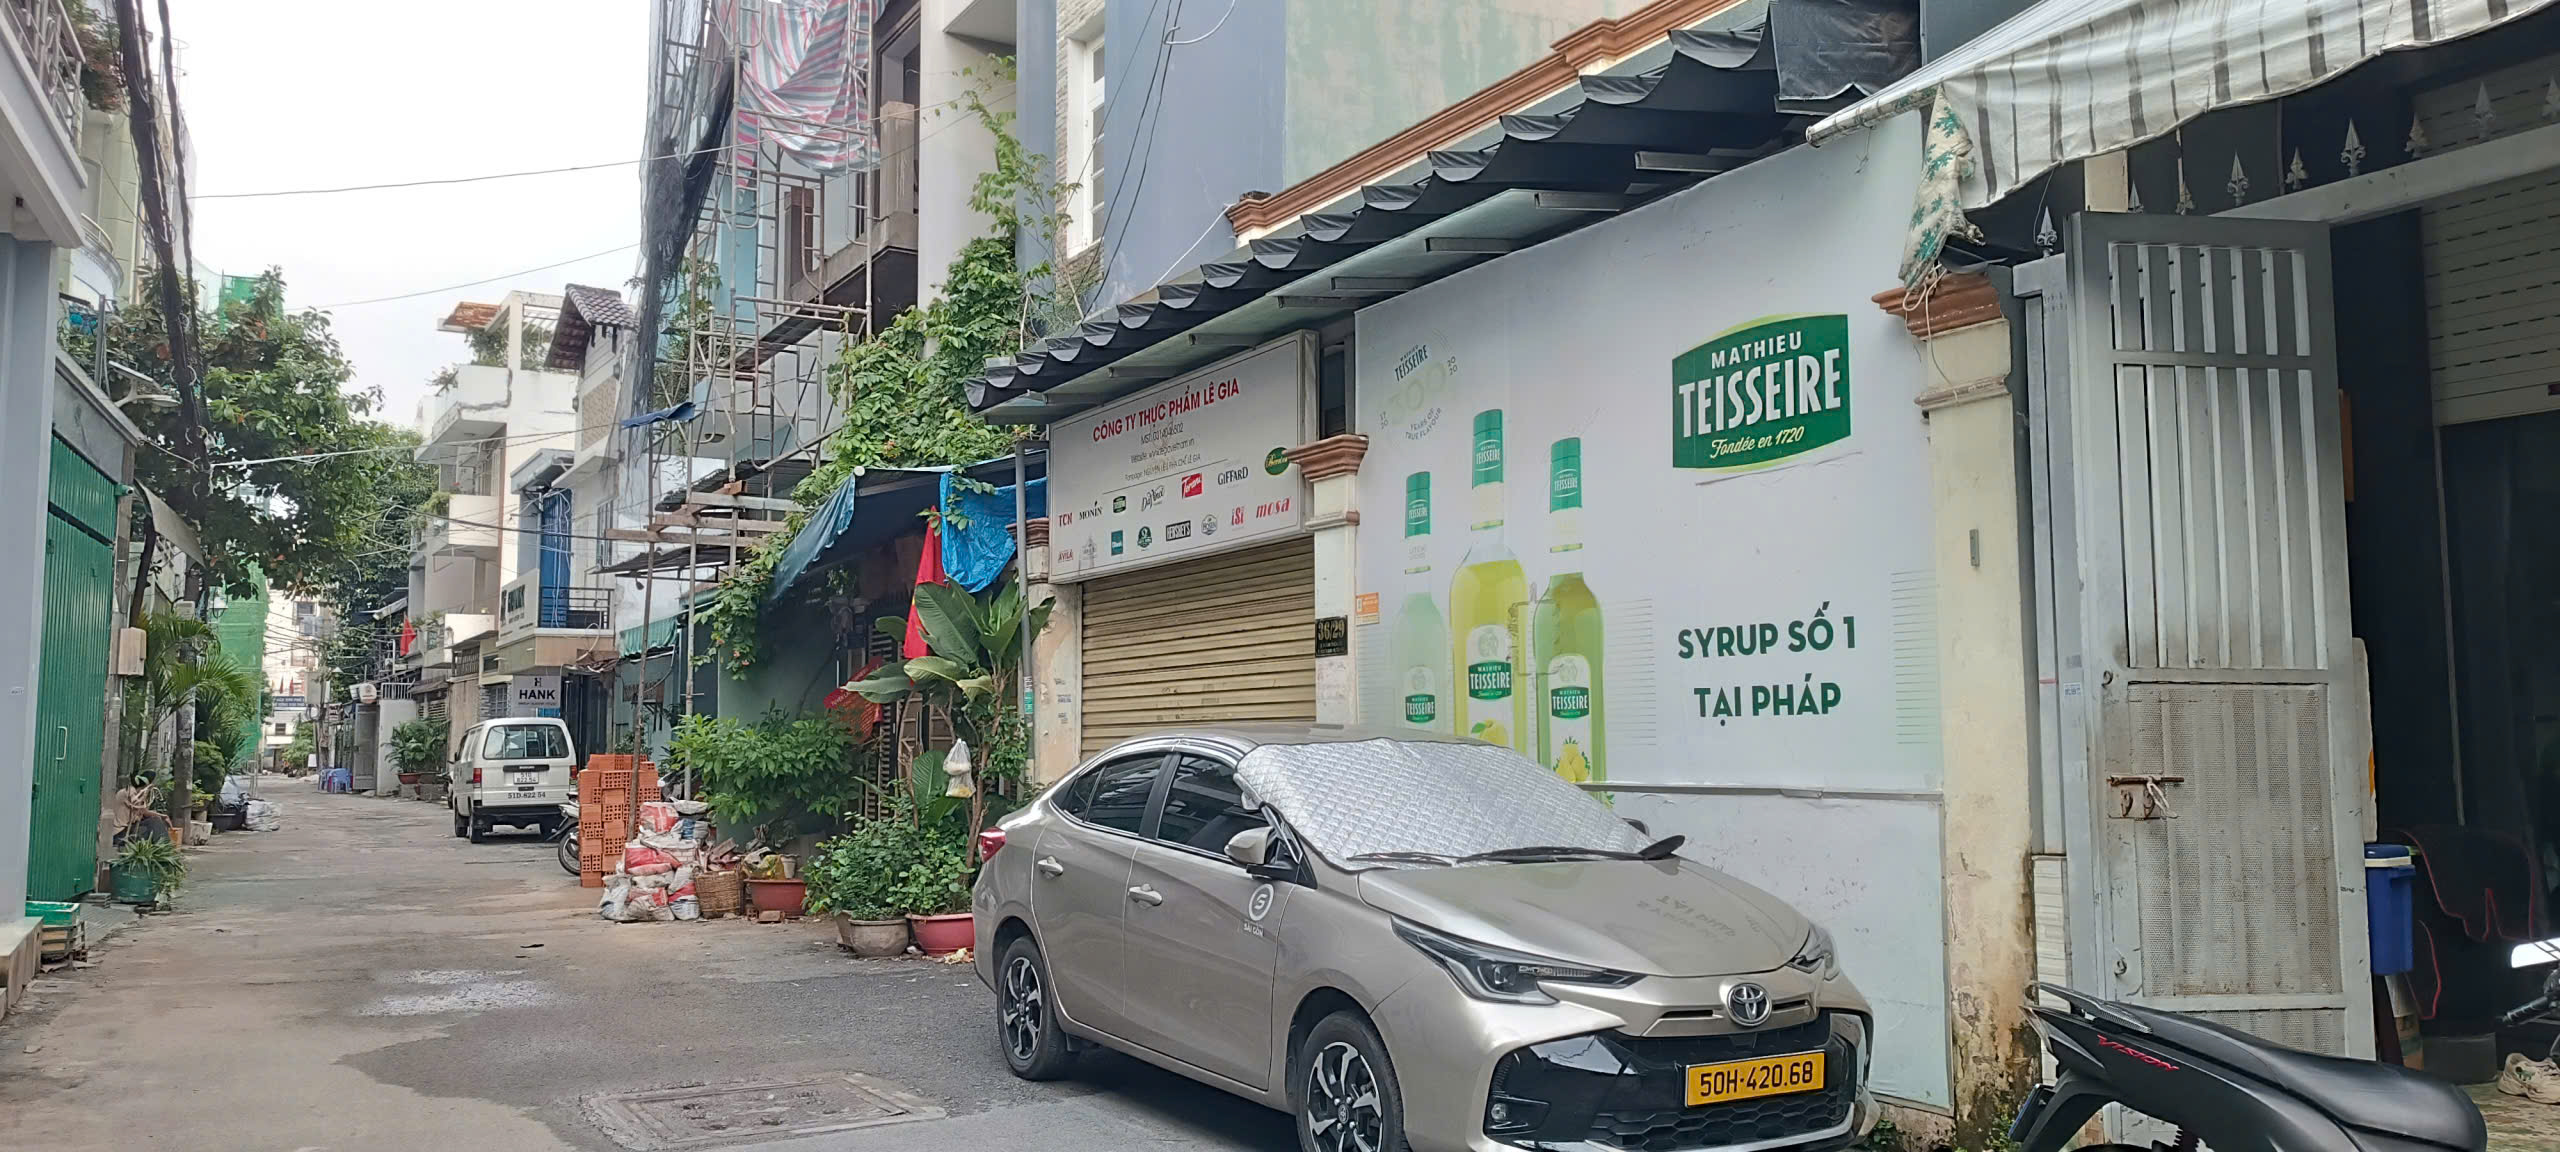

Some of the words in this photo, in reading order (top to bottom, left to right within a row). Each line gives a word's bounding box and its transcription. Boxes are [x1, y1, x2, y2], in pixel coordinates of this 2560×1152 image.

[1710, 331, 1802, 370] MATHIEU
[1394, 344, 1428, 382] TEISSEIRE
[1679, 348, 1841, 438] TEISSEIRE
[1093, 419, 1123, 442] CÔNG
[1125, 413, 1137, 432] TY
[1139, 403, 1166, 429] THỰC
[1169, 385, 1200, 417] PHẨM
[1203, 381, 1215, 405] LÊ
[1217, 378, 1240, 400] GIA
[1710, 437, 1755, 459] Fondée
[1758, 436, 1773, 448] en
[1775, 426, 1805, 445] 1720
[1217, 466, 1248, 485] GIFFARD
[1079, 501, 1103, 521] MONIN
[1231, 506, 1245, 526] iSi
[1256, 498, 1291, 519] mosa
[1318, 619, 1345, 640] 36/29
[1678, 623, 1778, 659] SYRUP
[1788, 601, 1834, 652] SỐ
[1843, 616, 1855, 649] 1
[1469, 672, 1511, 690] TEISSEIRE
[519, 689, 556, 700] HANK
[1552, 695, 1588, 710] TEISSEIRE
[1694, 686, 1742, 727] TẠI
[1752, 673, 1841, 717] PHÁP
[1406, 702, 1435, 716] TEISSEIRE
[2097, 1033, 2180, 1071] VISION
